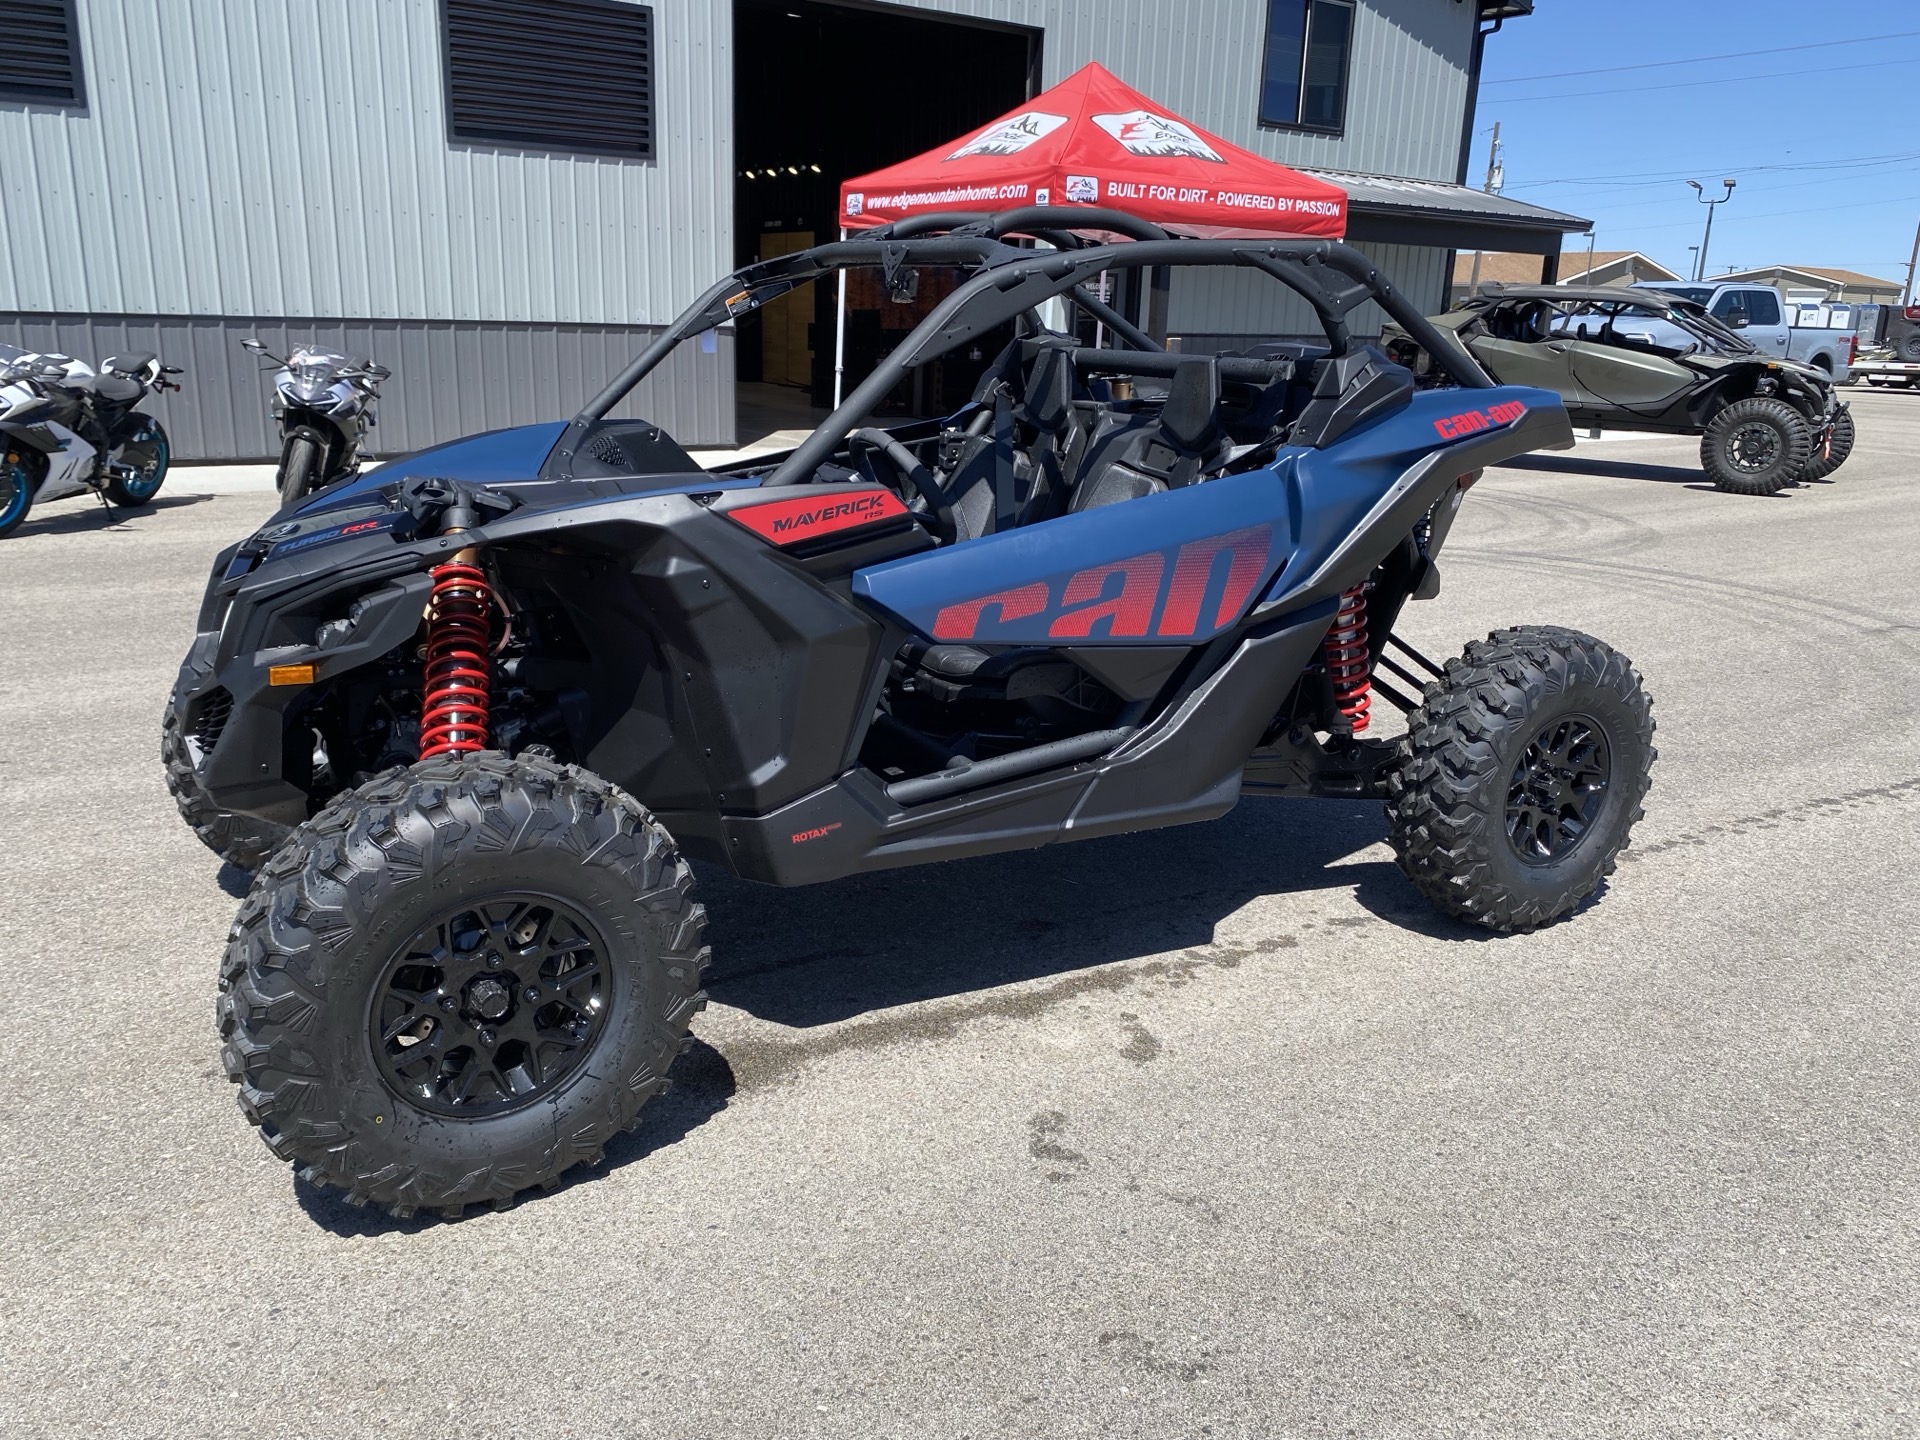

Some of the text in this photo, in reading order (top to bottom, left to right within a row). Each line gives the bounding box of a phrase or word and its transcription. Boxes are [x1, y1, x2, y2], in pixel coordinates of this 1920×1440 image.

[867, 184, 1028, 210] www.edgemountainhome.com
[1107, 181, 1147, 199] BUILT
[1149, 185, 1177, 201] FOR
[1178, 187, 1209, 203] DIRT
[1216, 191, 1276, 210] POWERED
[1278, 197, 1294, 211] BY
[1295, 200, 1341, 217] PASSION
[1433, 400, 1527, 440] can-am
[773, 494, 885, 533] MAVERICK
[864, 509, 884, 520] RS
[278, 521, 378, 553] TURBO RR
[791, 827, 828, 844] ROTAX
